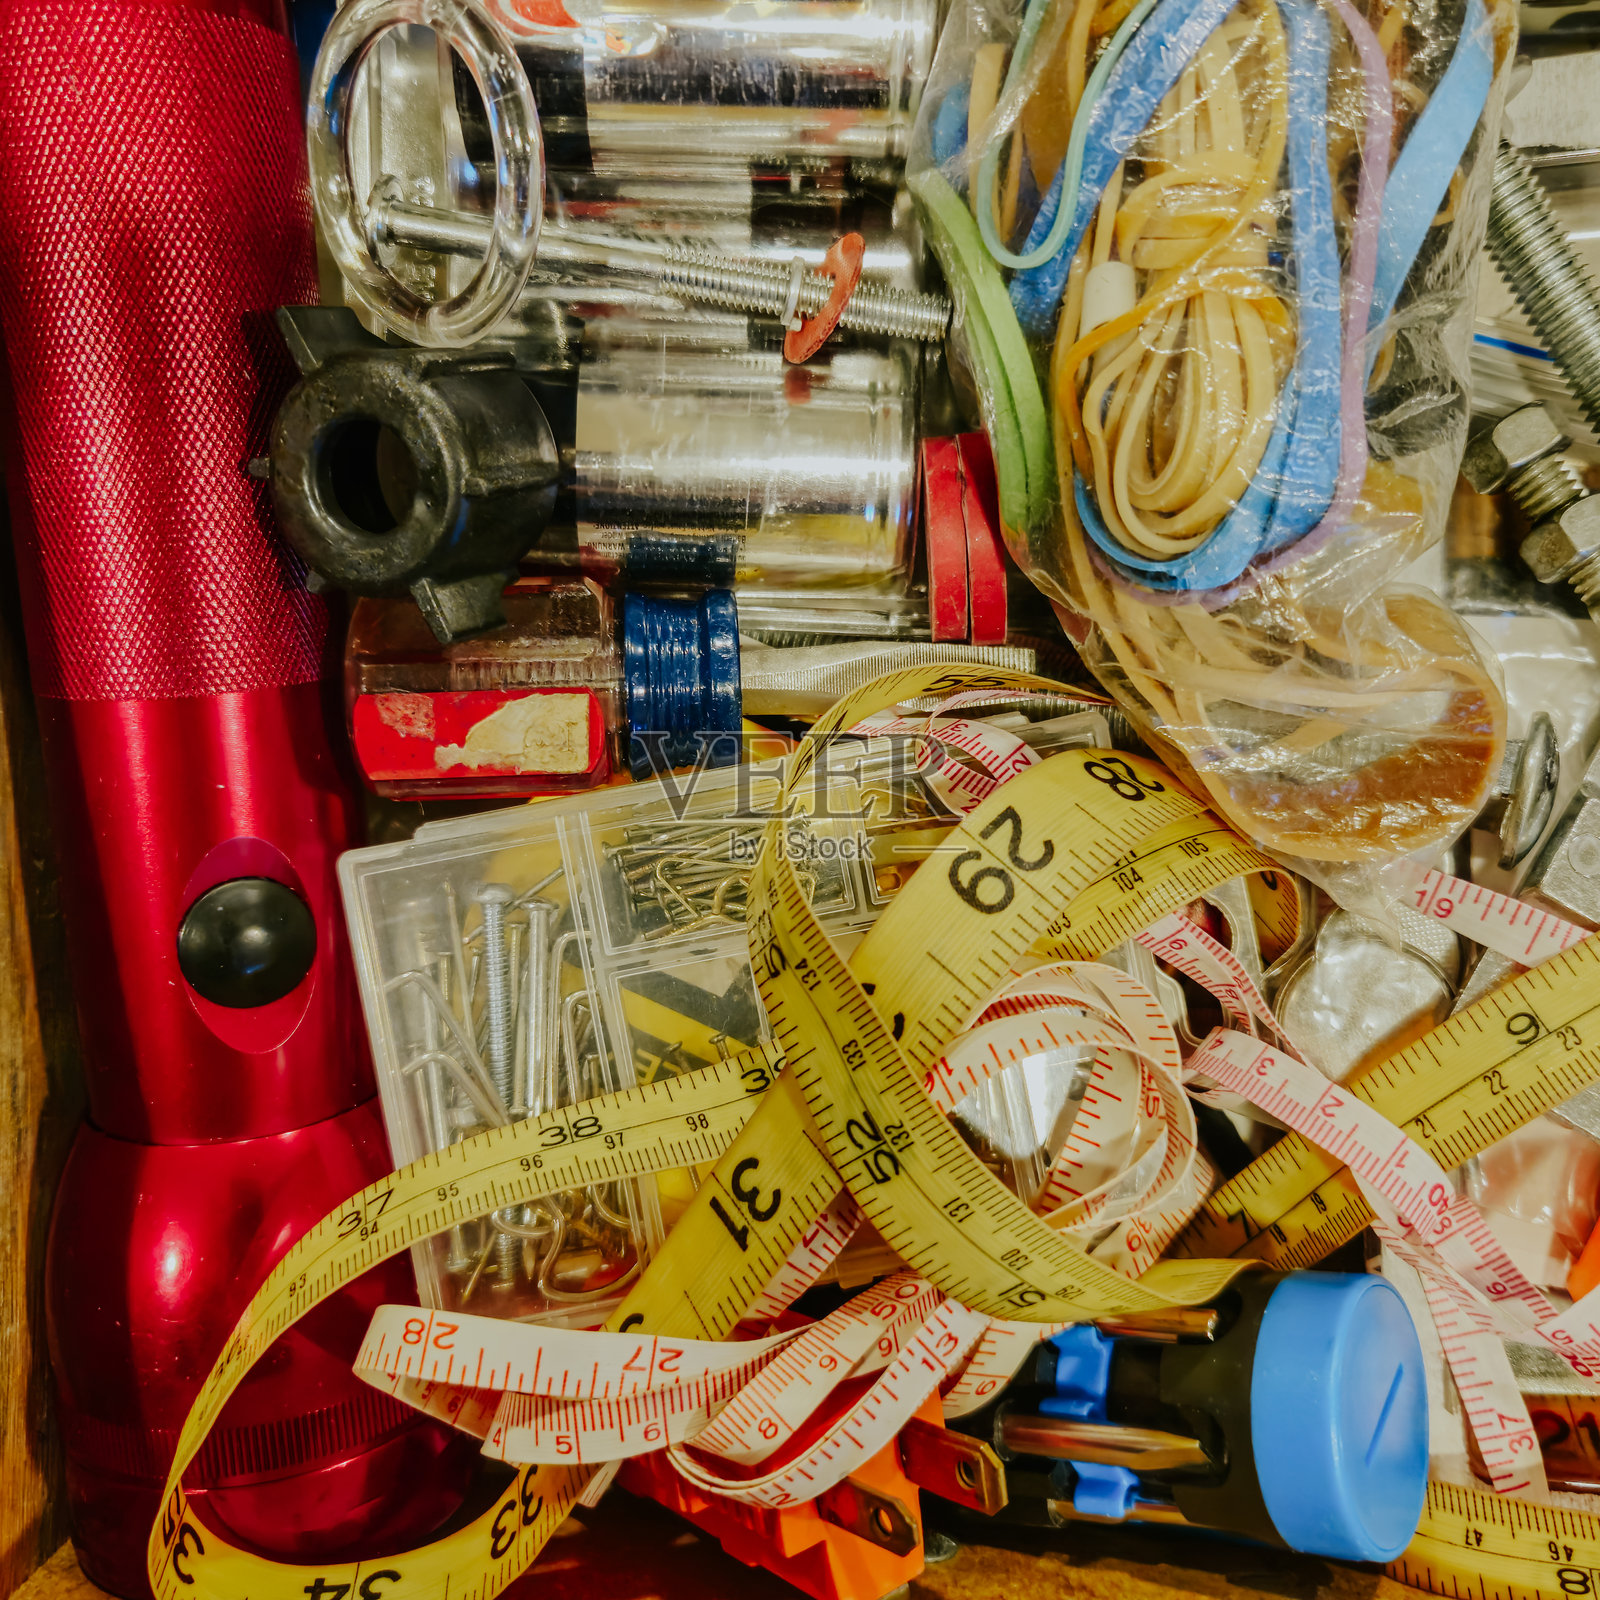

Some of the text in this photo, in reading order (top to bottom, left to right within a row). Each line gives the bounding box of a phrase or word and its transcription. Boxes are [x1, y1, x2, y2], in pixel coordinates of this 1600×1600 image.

[922, 674, 1019, 693] 55
[1012, 753, 1032, 773] 2
[1083, 757, 1166, 802] 28
[948, 805, 1055, 915] 29
[1178, 838, 1209, 859] 105
[1112, 867, 1145, 894] 104
[1414, 889, 1455, 919] 19
[795, 958, 822, 991] 134
[1505, 1011, 1540, 1045] 9
[1556, 1025, 1583, 1051] 23
[842, 1039, 867, 1072] 133
[1256, 1057, 1275, 1076] 3
[1483, 1070, 1509, 1095] 22
[1319, 1095, 1345, 1117] 2
[538, 1116, 603, 1147] 38
[685, 1113, 709, 1132] 98
[1414, 1114, 1437, 1139] 21
[604, 1132, 625, 1150] 97
[846, 1111, 899, 1186] 52
[885, 1120, 915, 1154] 132
[520, 1154, 544, 1172] 96
[437, 1182, 460, 1201] 95
[1310, 1192, 1327, 1214] 19
[1428, 1183, 1449, 1216] 40
[338, 1188, 394, 1238] 37
[709, 1157, 781, 1252] 31
[942, 1197, 976, 1224] 131
[360, 1221, 379, 1241] 94
[1227, 1207, 1251, 1240] 7
[1269, 1223, 1287, 1246] 18
[1001, 1248, 1034, 1271] 130
[289, 1273, 306, 1297] 93
[998, 1282, 1046, 1308] 51
[1055, 1285, 1085, 1300] 129
[870, 1283, 919, 1320] 50
[403, 1318, 460, 1350] 28
[623, 1346, 685, 1373] 27
[819, 1355, 838, 1373] 9
[921, 1332, 959, 1372] 13
[492, 1427, 502, 1448] 4
[643, 1422, 661, 1442] 6
[758, 1418, 779, 1440] 8
[1497, 1412, 1535, 1455] 37
[555, 1435, 574, 1455] 5
[490, 1463, 544, 1560] 33
[1465, 1526, 1483, 1547] 47
[1548, 1541, 1574, 1562] 46
[1557, 1568, 1600, 1595] 8
